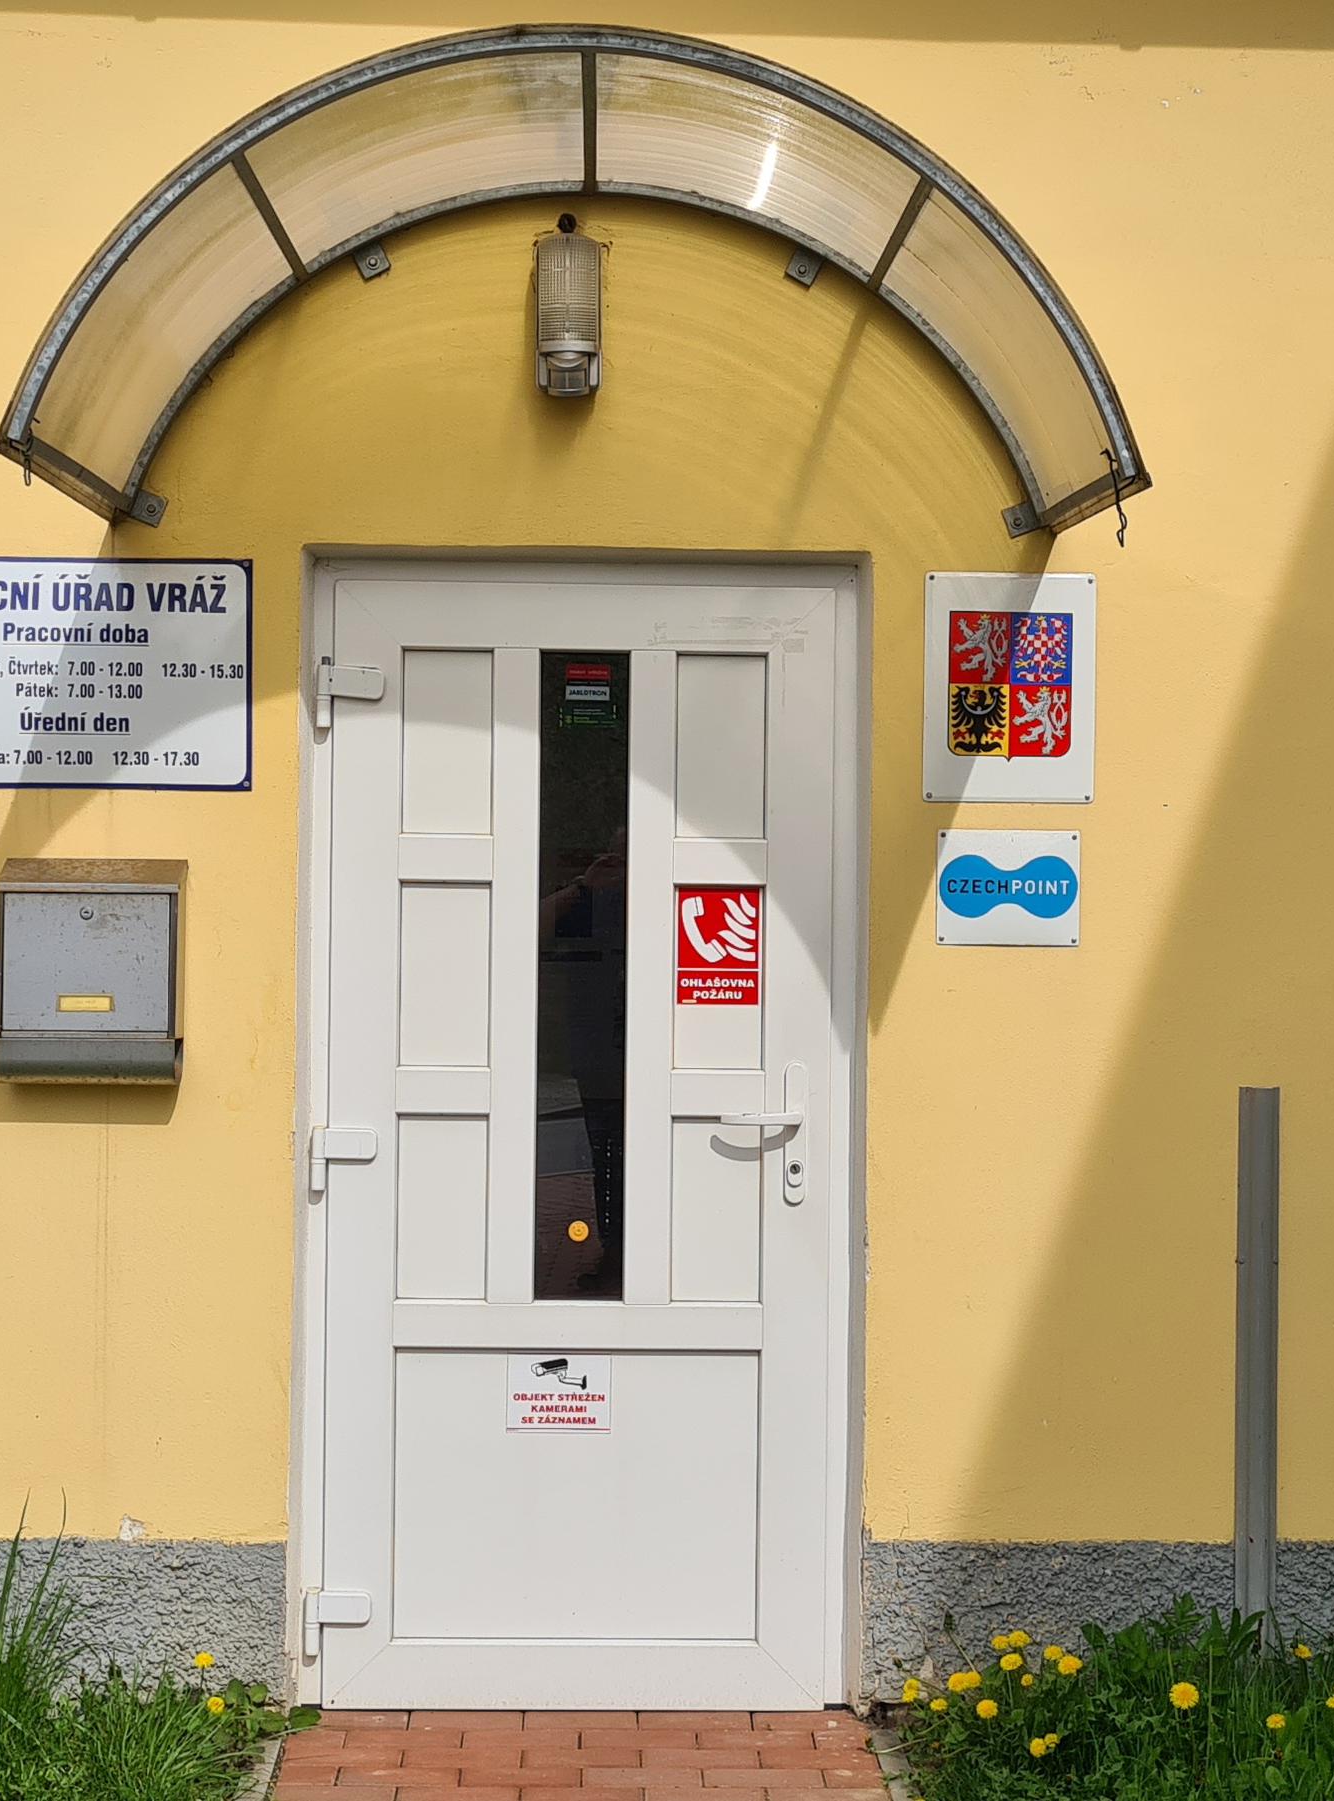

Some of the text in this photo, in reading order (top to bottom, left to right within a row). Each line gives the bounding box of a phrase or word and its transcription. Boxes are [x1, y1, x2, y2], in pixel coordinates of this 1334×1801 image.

[52, 574, 135, 612] ÚŘAD
[146, 575, 227, 614] VRÁŽ
[3, 622, 149, 644] Pracovní doba
[8, 656, 59, 676] Čtvrtek:
[67, 661, 95, 676] 7.00
[107, 662, 143, 677] 12.00
[161, 663, 197, 678] 12.30
[209, 664, 244, 679] 15.30
[16, 682, 59, 698] Pátek:
[67, 683, 95, 699] 7.00
[107, 684, 143, 699] 13.00
[19, 706, 130, 733] Úřední den
[13, 750, 43, 765] 7.00
[55, 750, 93, 766] 12.00
[112, 751, 149, 766] 12.30
[162, 751, 200, 767] 17.30
[680, 976, 755, 988] OHLAŠOVNA
[693, 988, 743, 1000] POŽÁRU
[513, 1391, 606, 1402] OBJEKT STŘEŽEN
[531, 1404, 587, 1413] KAMERAMI
[521, 1414, 597, 1425] SE ZÁZNAMEM
